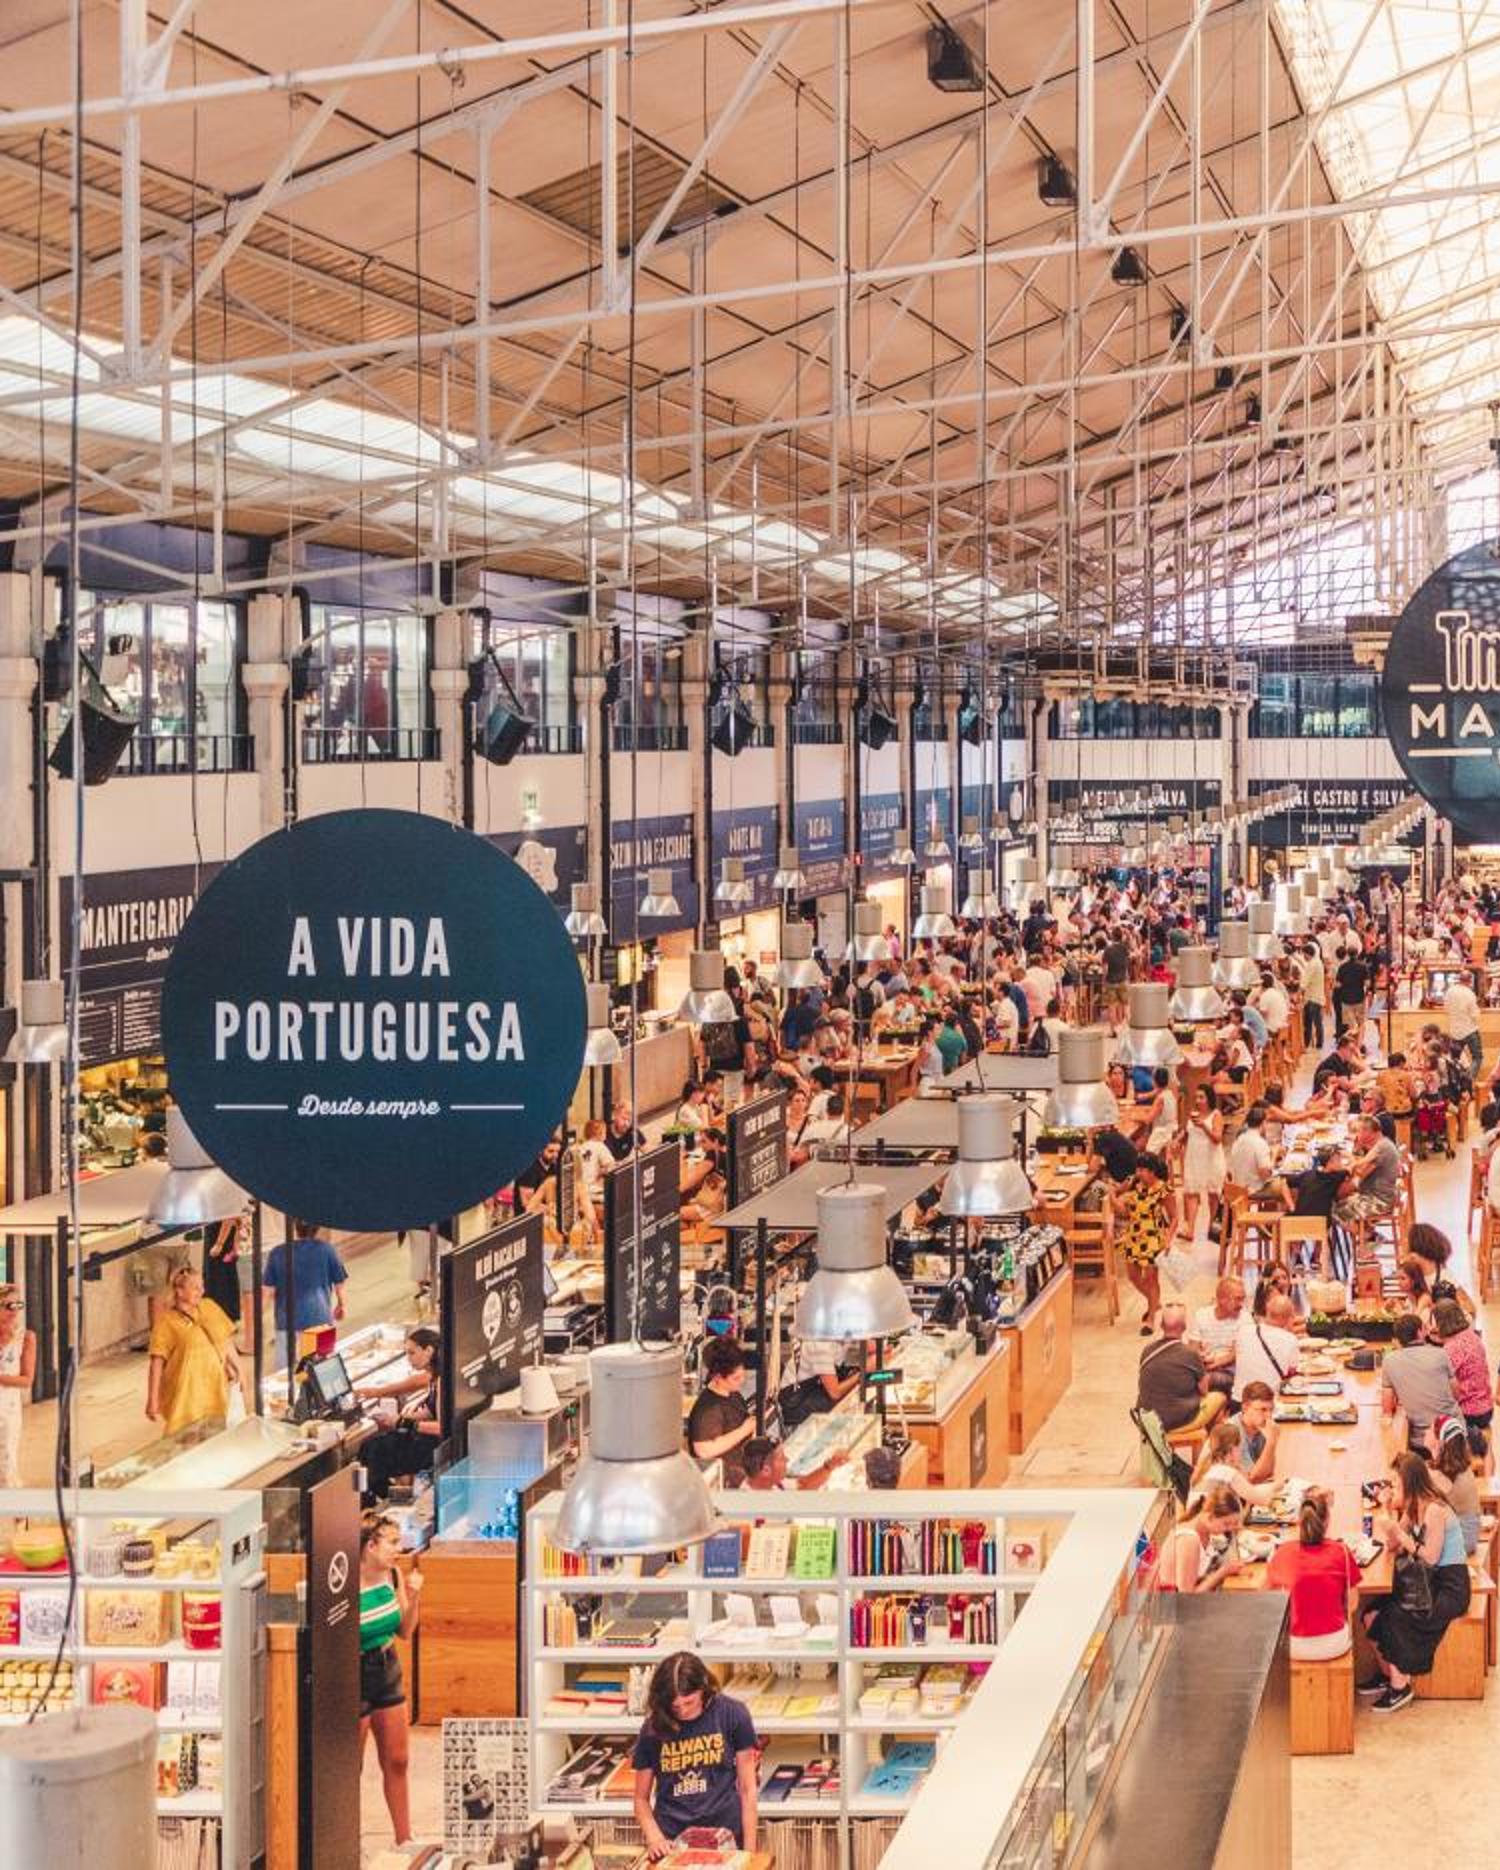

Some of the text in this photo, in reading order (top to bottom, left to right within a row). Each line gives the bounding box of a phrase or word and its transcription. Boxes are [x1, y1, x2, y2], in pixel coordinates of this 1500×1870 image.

[1313, 790, 1358, 806] CASTRO
[288, 917, 450, 976] A VIDA
[216, 1001, 525, 1062] PORTUGUESA
[298, 1095, 440, 1119] Desde sempre
[661, 1733, 723, 1756] ALWAYS
